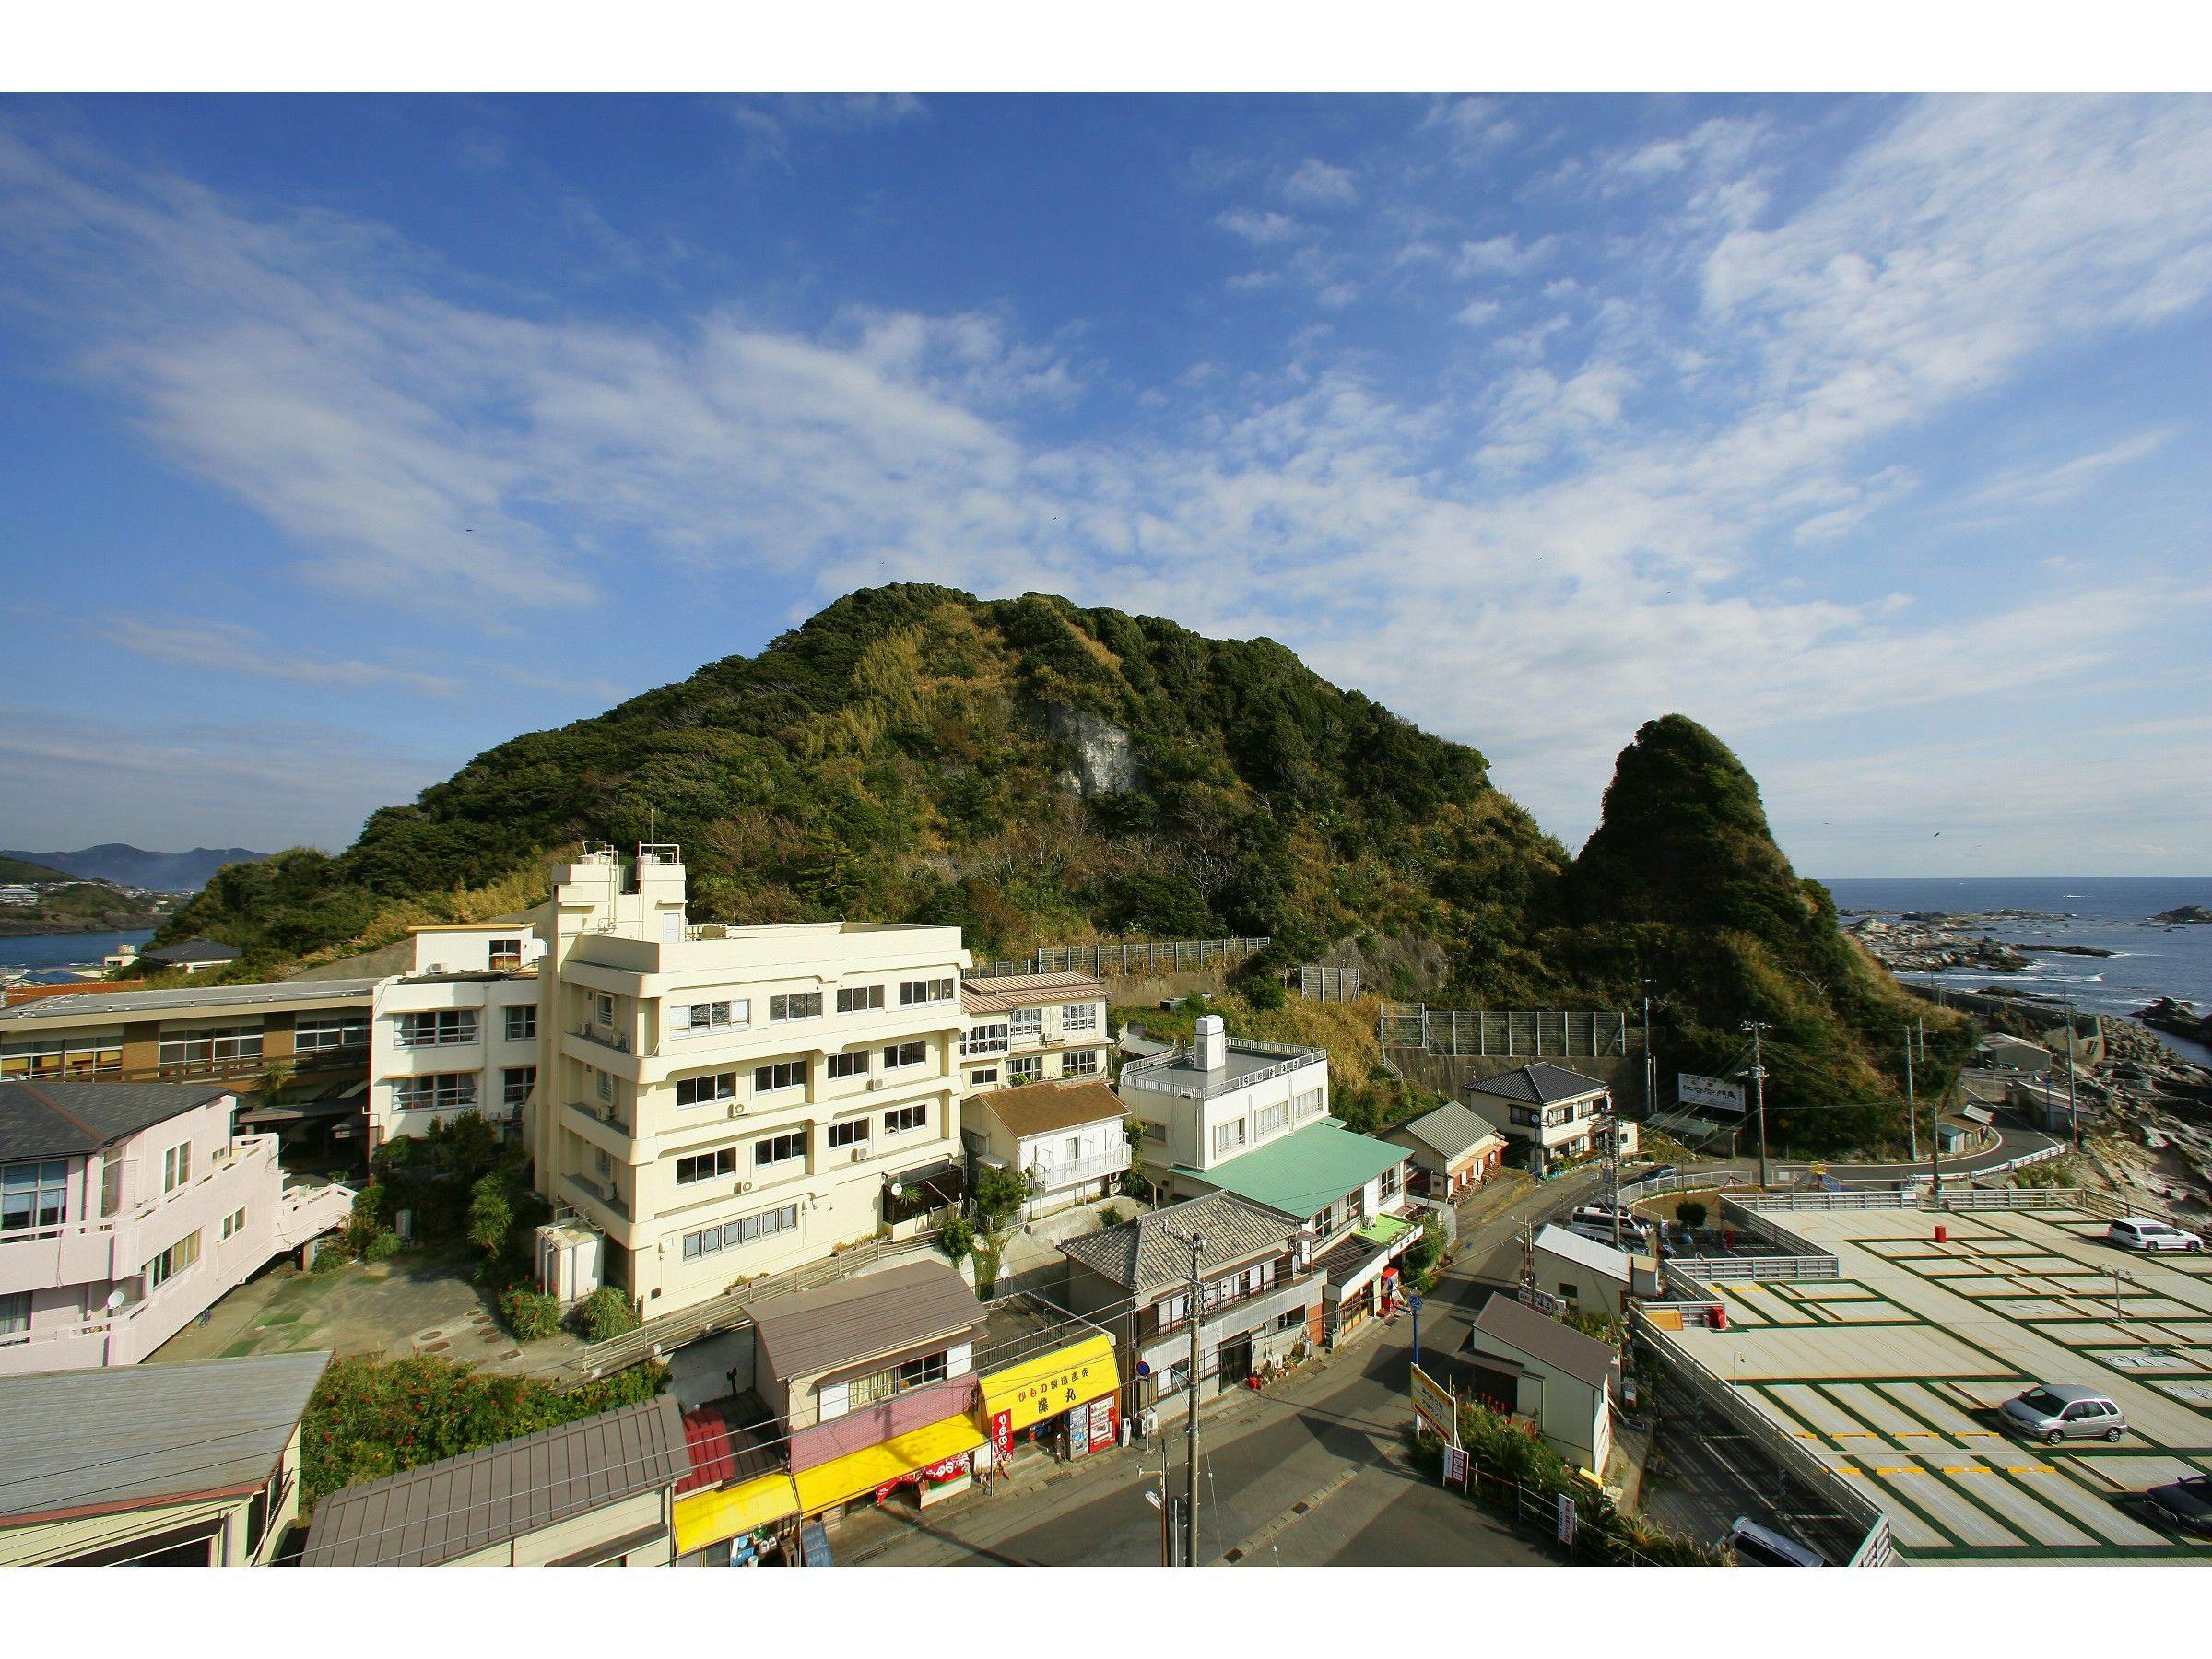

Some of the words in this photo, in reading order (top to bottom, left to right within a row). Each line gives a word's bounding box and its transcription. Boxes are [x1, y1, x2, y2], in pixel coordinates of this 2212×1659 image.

[1018, 1367, 1089, 1402] ひもの製造直売
